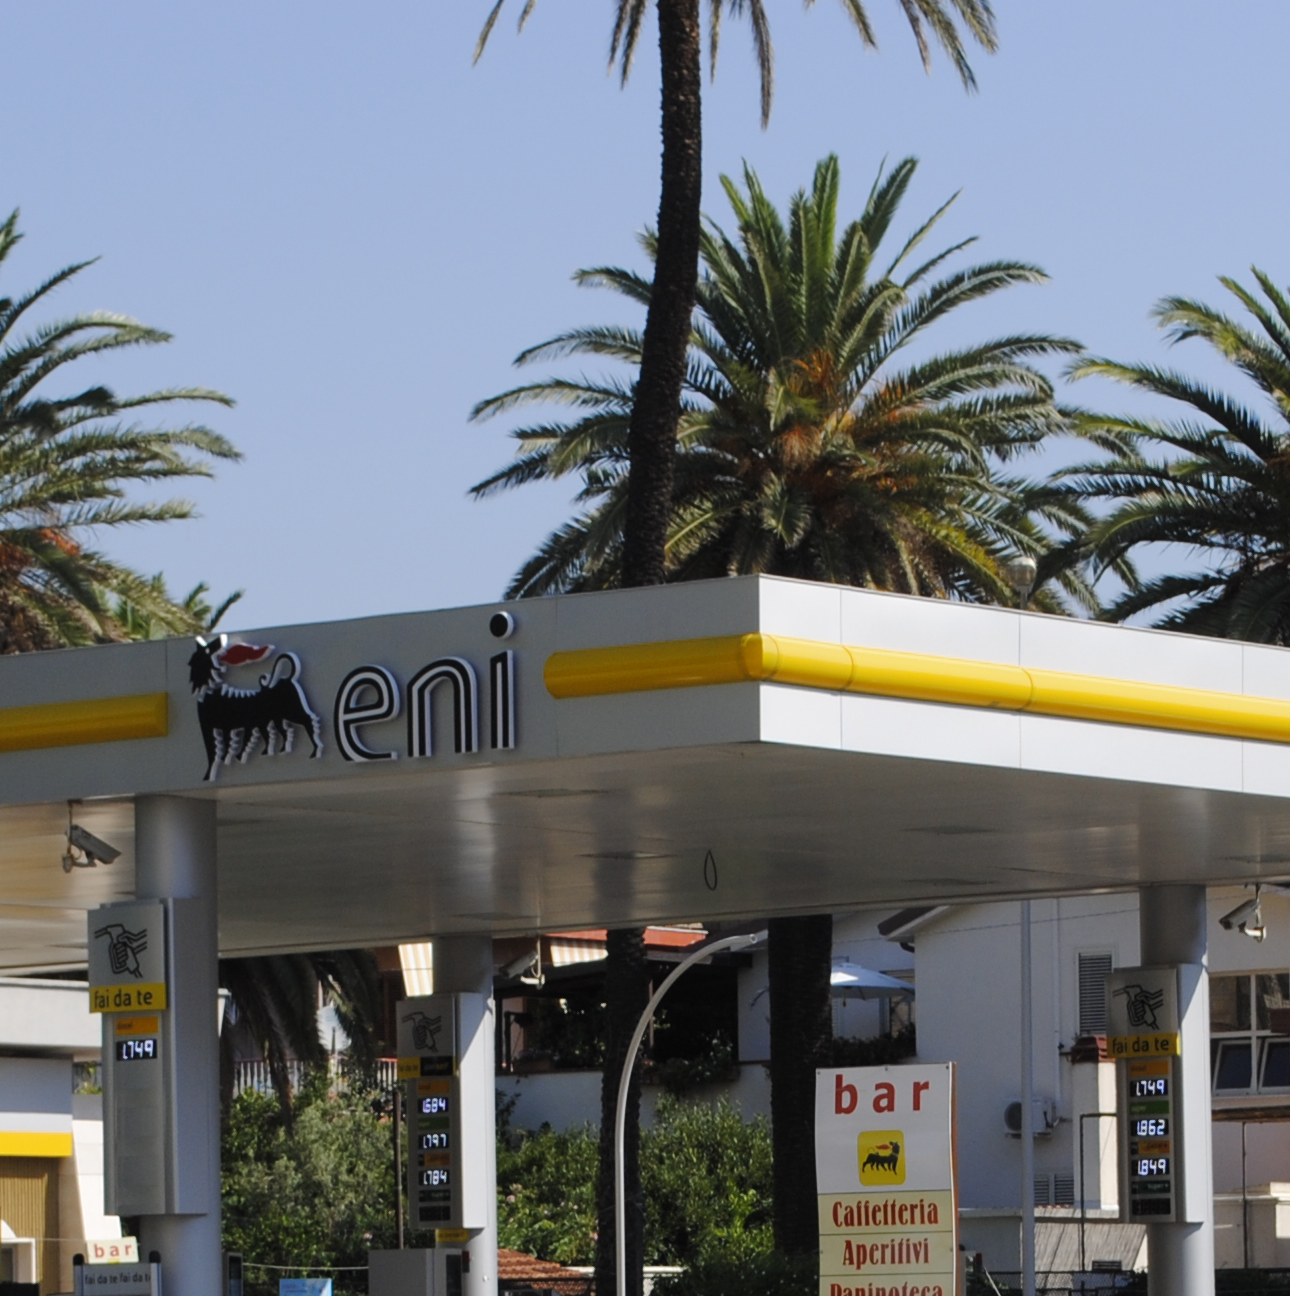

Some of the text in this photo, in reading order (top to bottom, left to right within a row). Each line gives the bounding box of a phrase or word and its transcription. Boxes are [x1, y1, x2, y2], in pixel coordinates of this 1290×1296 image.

[333, 610, 516, 762] eni
[94, 988, 154, 1010] fai da te
[1112, 1037, 1170, 1054] fai da te
[834, 1074, 930, 1115] bar
[832, 1198, 939, 1228] Caffetteria
[94, 1244, 131, 1258] bar
[842, 1237, 930, 1270] Aperitivi
[84, 1275, 96, 1286] fai
[97, 1273, 108, 1285] da
[109, 1273, 119, 1284] te
[120, 1272, 131, 1283] fai
[132, 1270, 143, 1282] da
